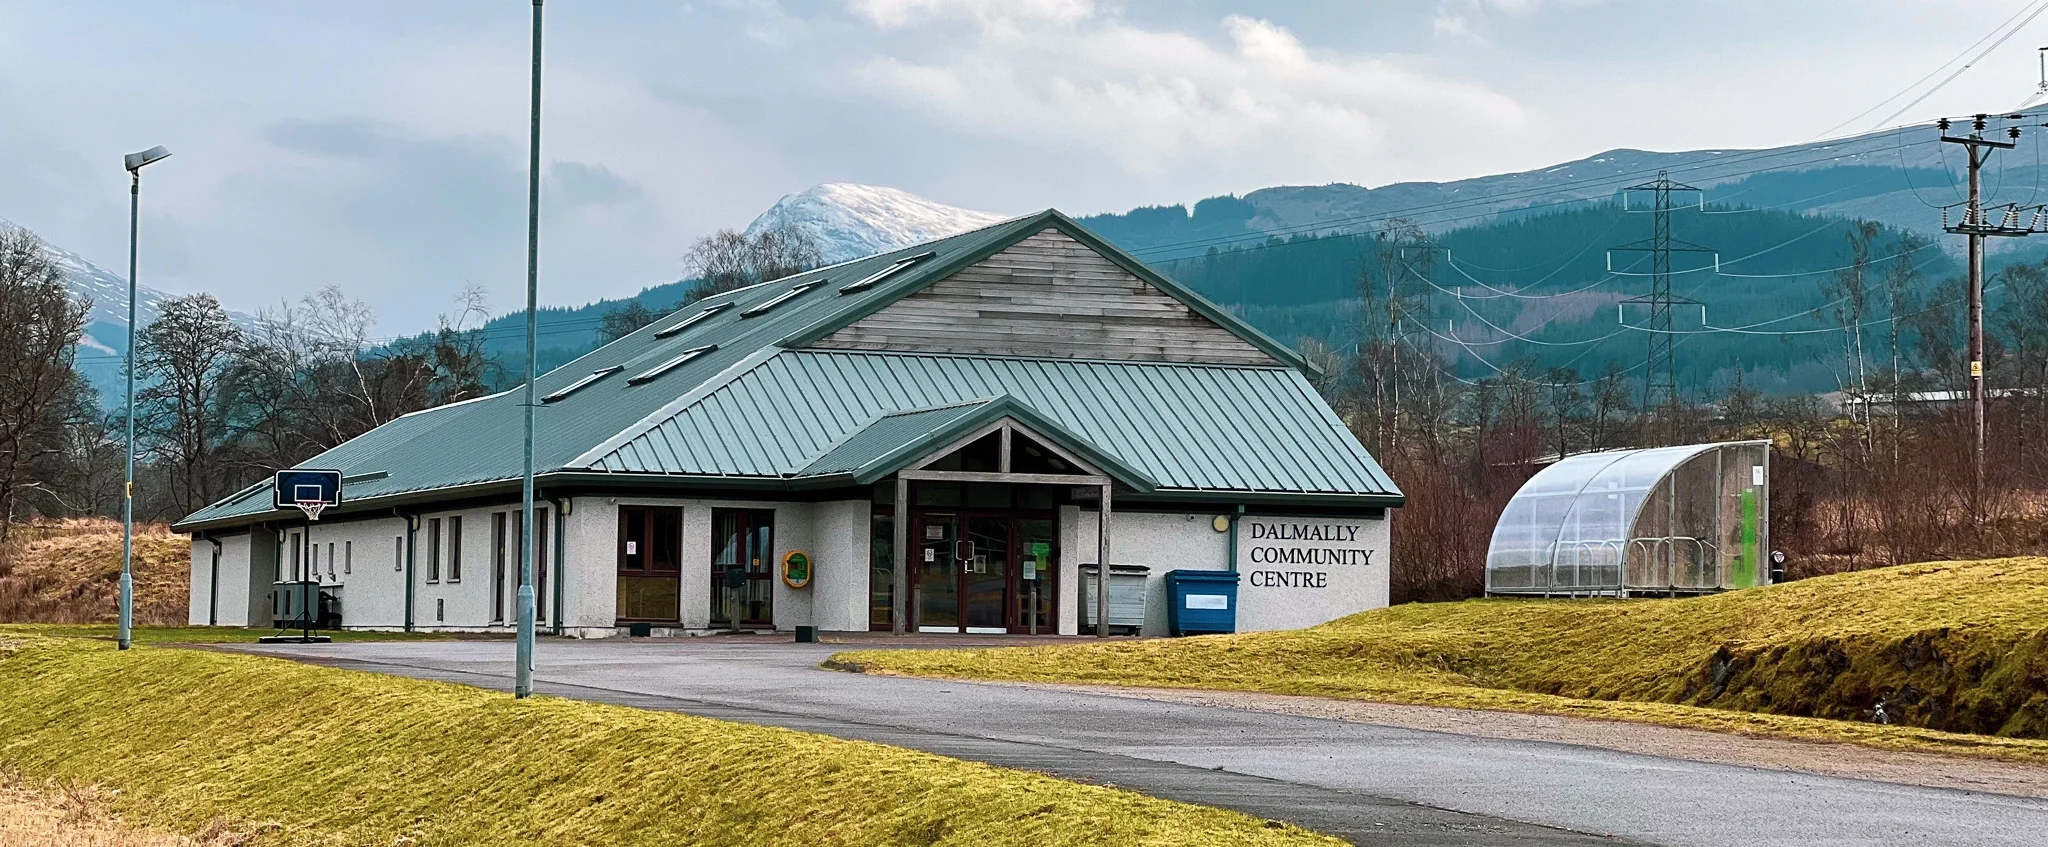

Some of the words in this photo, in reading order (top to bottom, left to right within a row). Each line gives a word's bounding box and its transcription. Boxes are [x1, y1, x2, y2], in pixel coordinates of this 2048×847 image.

[1251, 522, 1361, 542] DALMALLY
[1250, 547, 1375, 566] COMMUNITY
[1250, 570, 1328, 588] CENTRE
